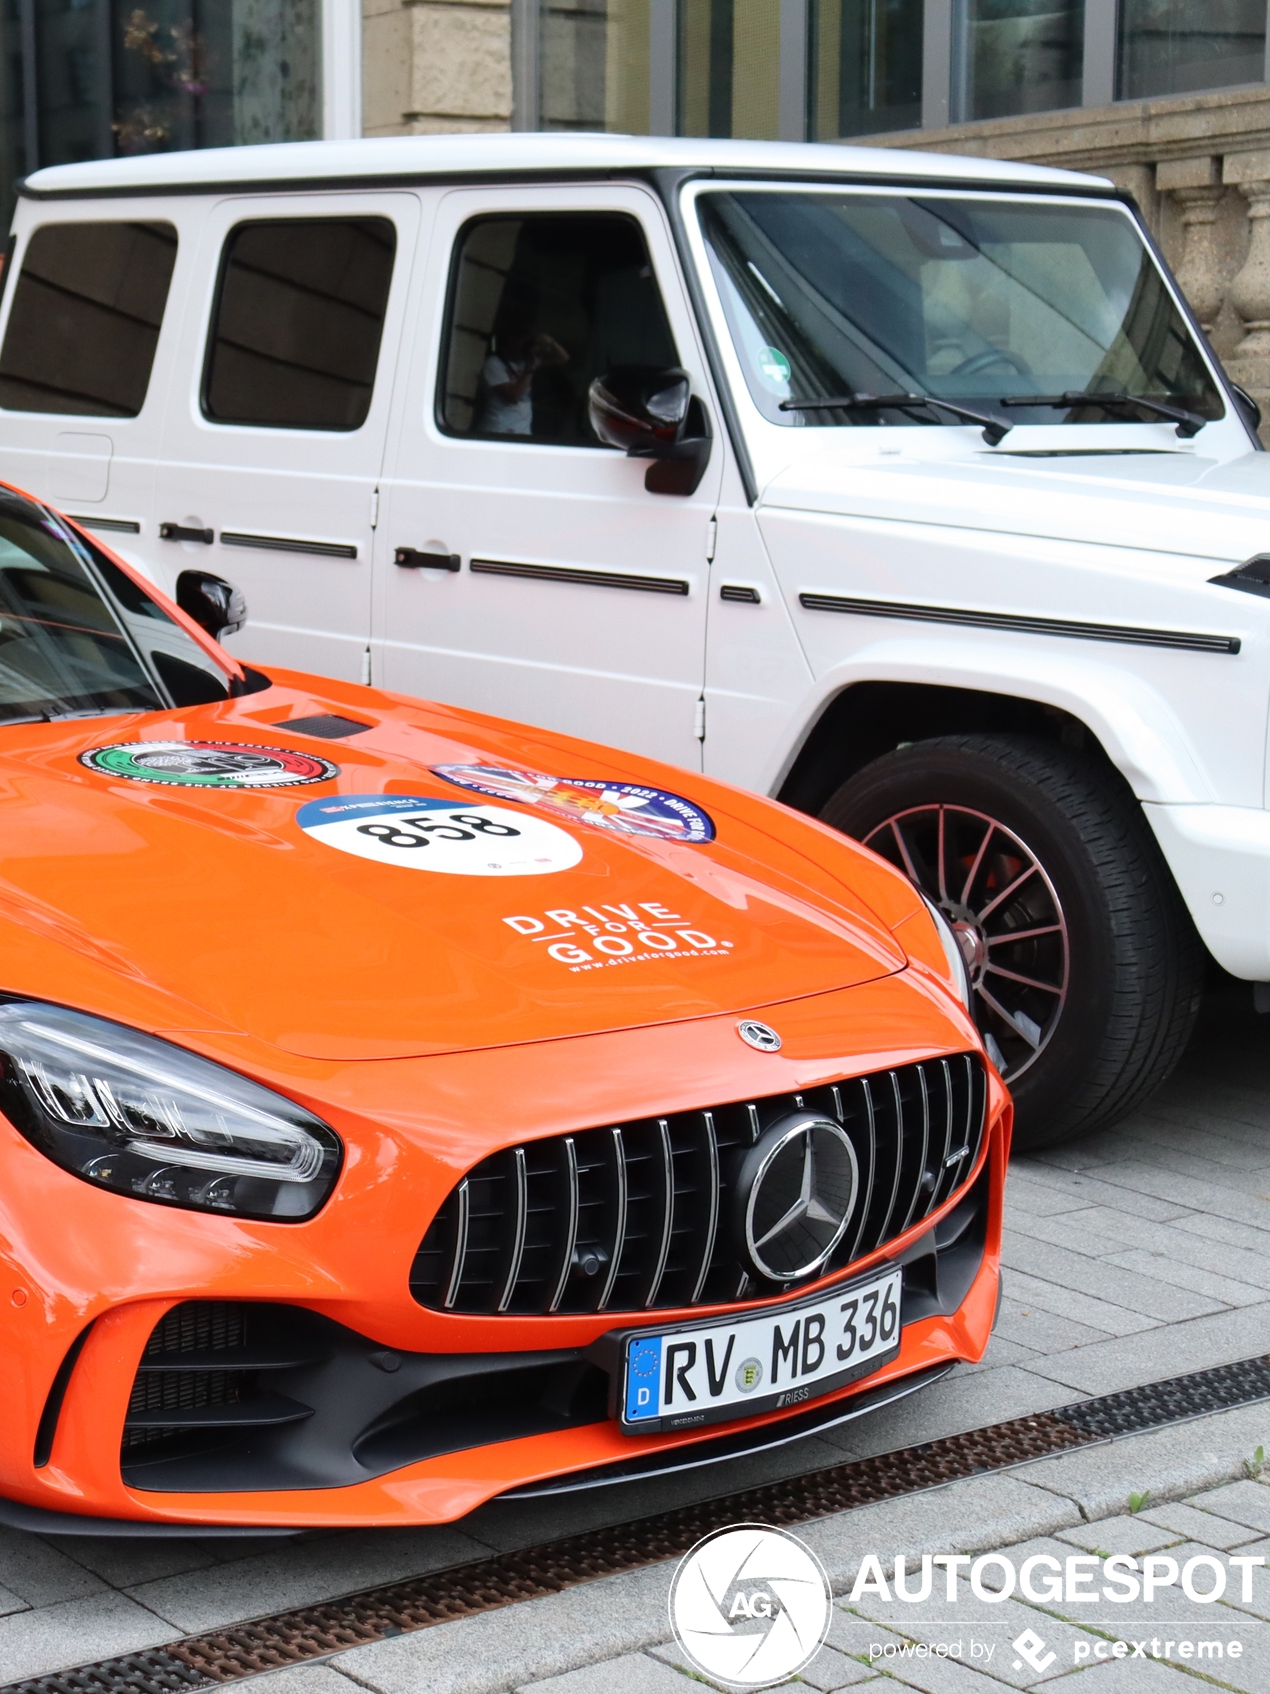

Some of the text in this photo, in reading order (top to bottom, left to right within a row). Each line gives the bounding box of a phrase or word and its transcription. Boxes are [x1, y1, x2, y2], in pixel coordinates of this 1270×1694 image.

[562, 778, 607, 790] GOOD
[620, 785, 658, 800] 2022
[664, 798, 698, 819] DRIVE
[356, 814, 522, 849] 858
[501, 902, 682, 935] DRIVE
[582, 920, 652, 937] FOR
[568, 949, 730, 973] www.driveforgood.com
[664, 1333, 736, 1405] RV
[771, 1312, 826, 1384] MB
[836, 1282, 897, 1362] 336
[637, 1387, 650, 1406] D
[784, 1387, 810, 1406] RIESS
